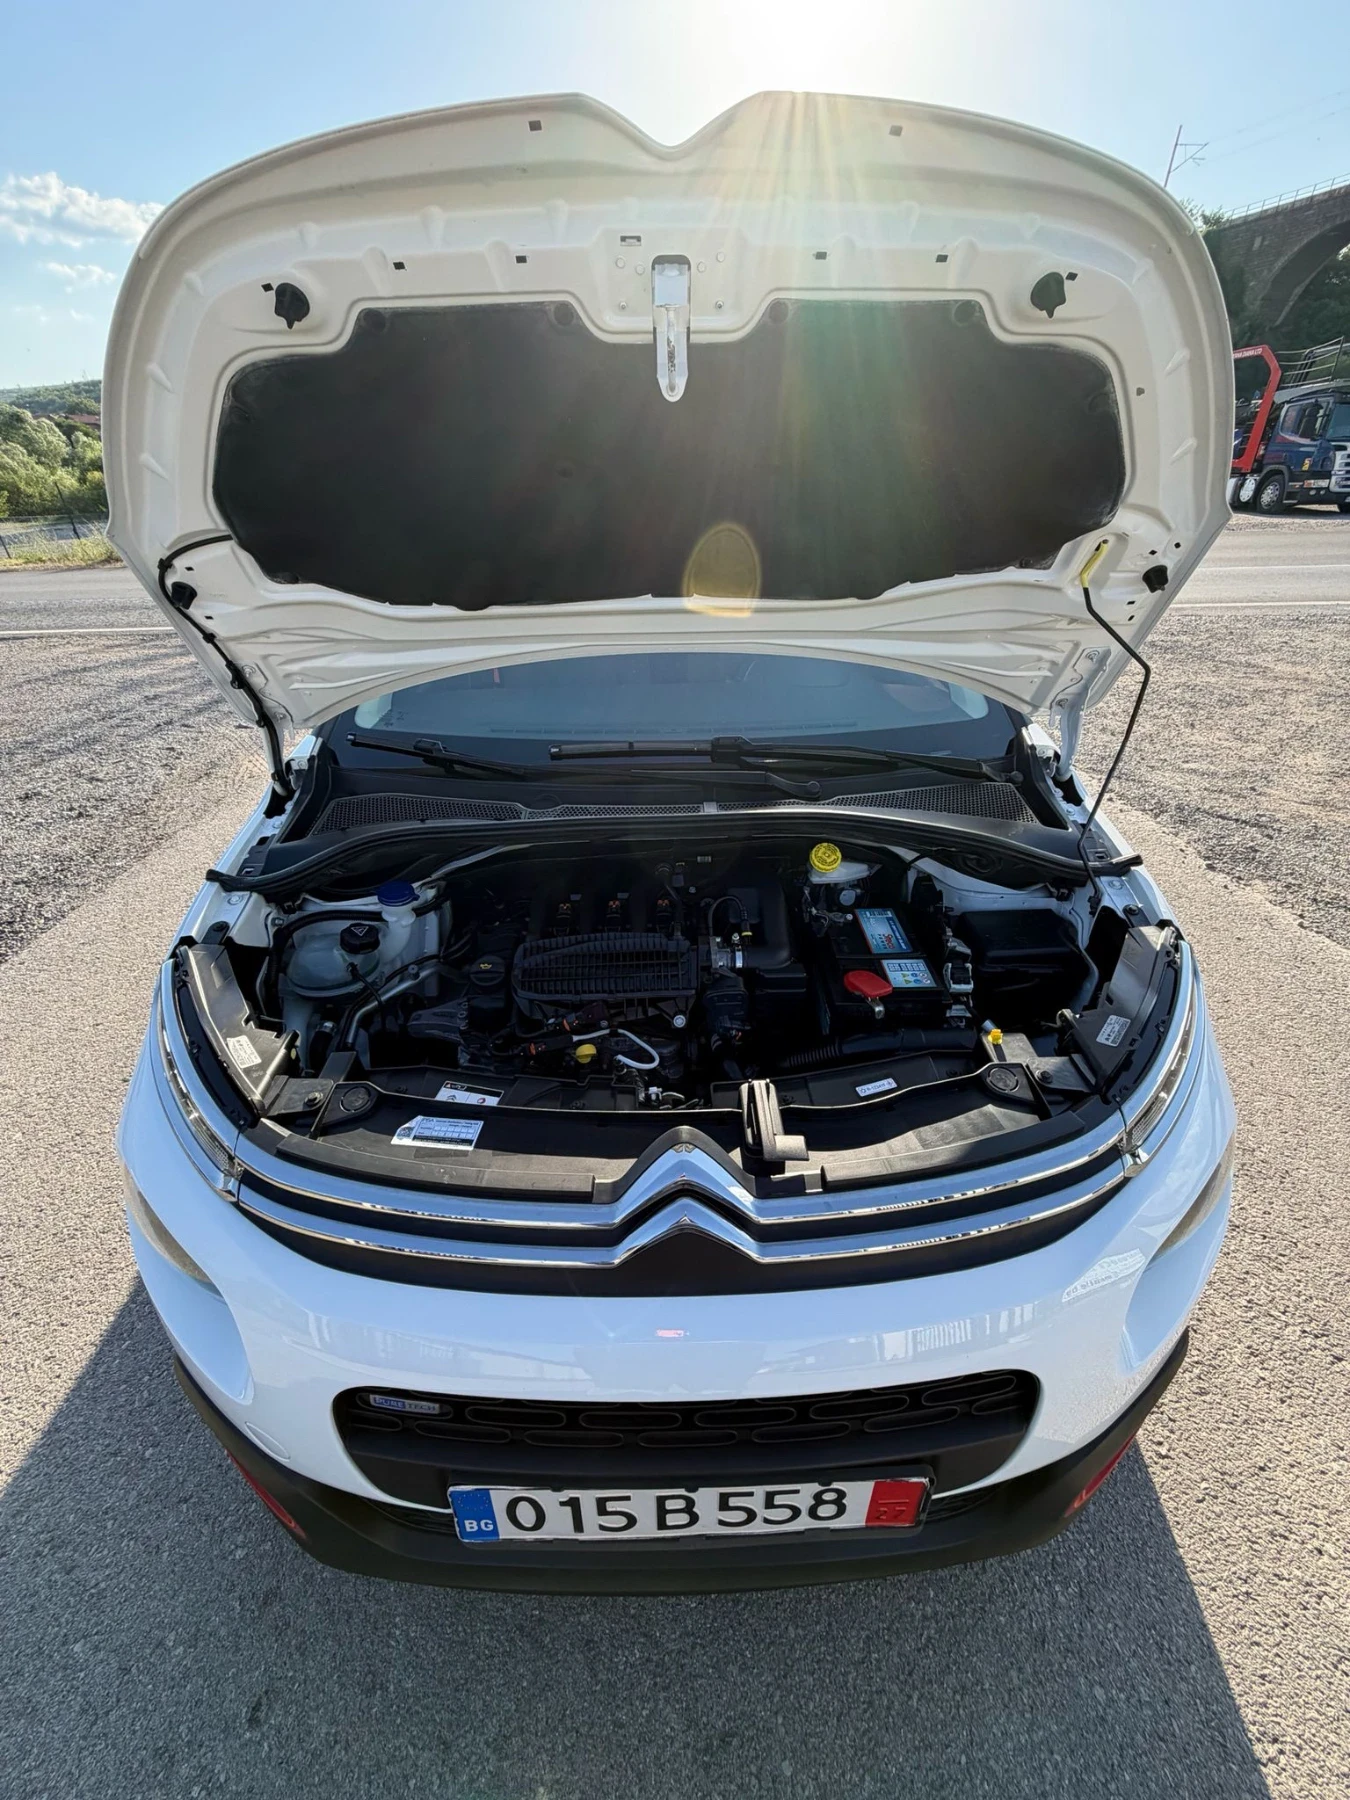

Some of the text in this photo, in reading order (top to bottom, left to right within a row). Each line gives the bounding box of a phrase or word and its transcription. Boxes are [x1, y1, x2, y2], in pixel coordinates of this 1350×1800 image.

[506, 1487, 848, 1533] 015 B 558
[464, 1519, 494, 1532] BG
